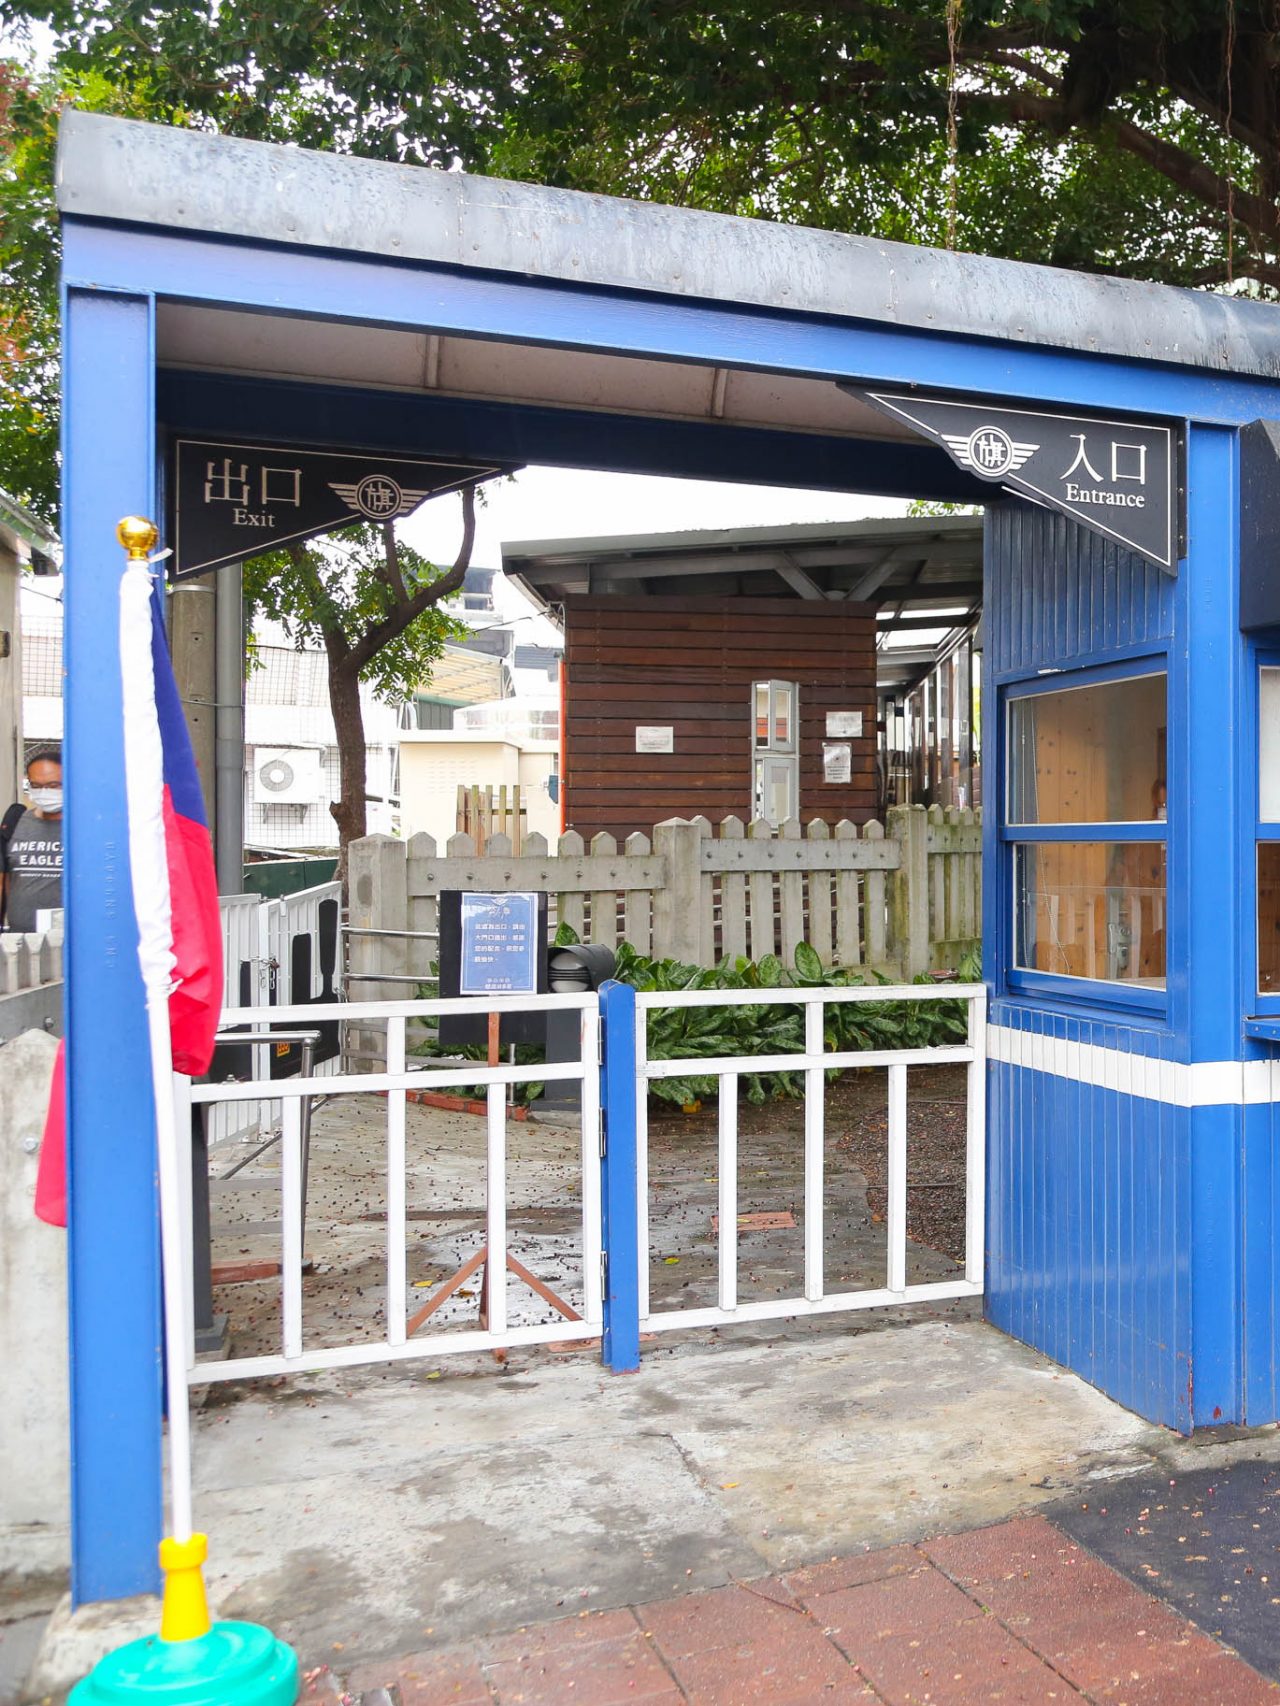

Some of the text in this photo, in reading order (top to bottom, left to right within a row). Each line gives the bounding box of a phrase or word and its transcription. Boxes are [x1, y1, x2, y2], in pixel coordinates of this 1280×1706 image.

[1059, 433, 1148, 486] 入口
[204, 458, 302, 507] 出口
[1065, 482, 1146, 508] Entrance
[232, 507, 276, 528] Exit
[20, 854, 64, 866] EAGLE
